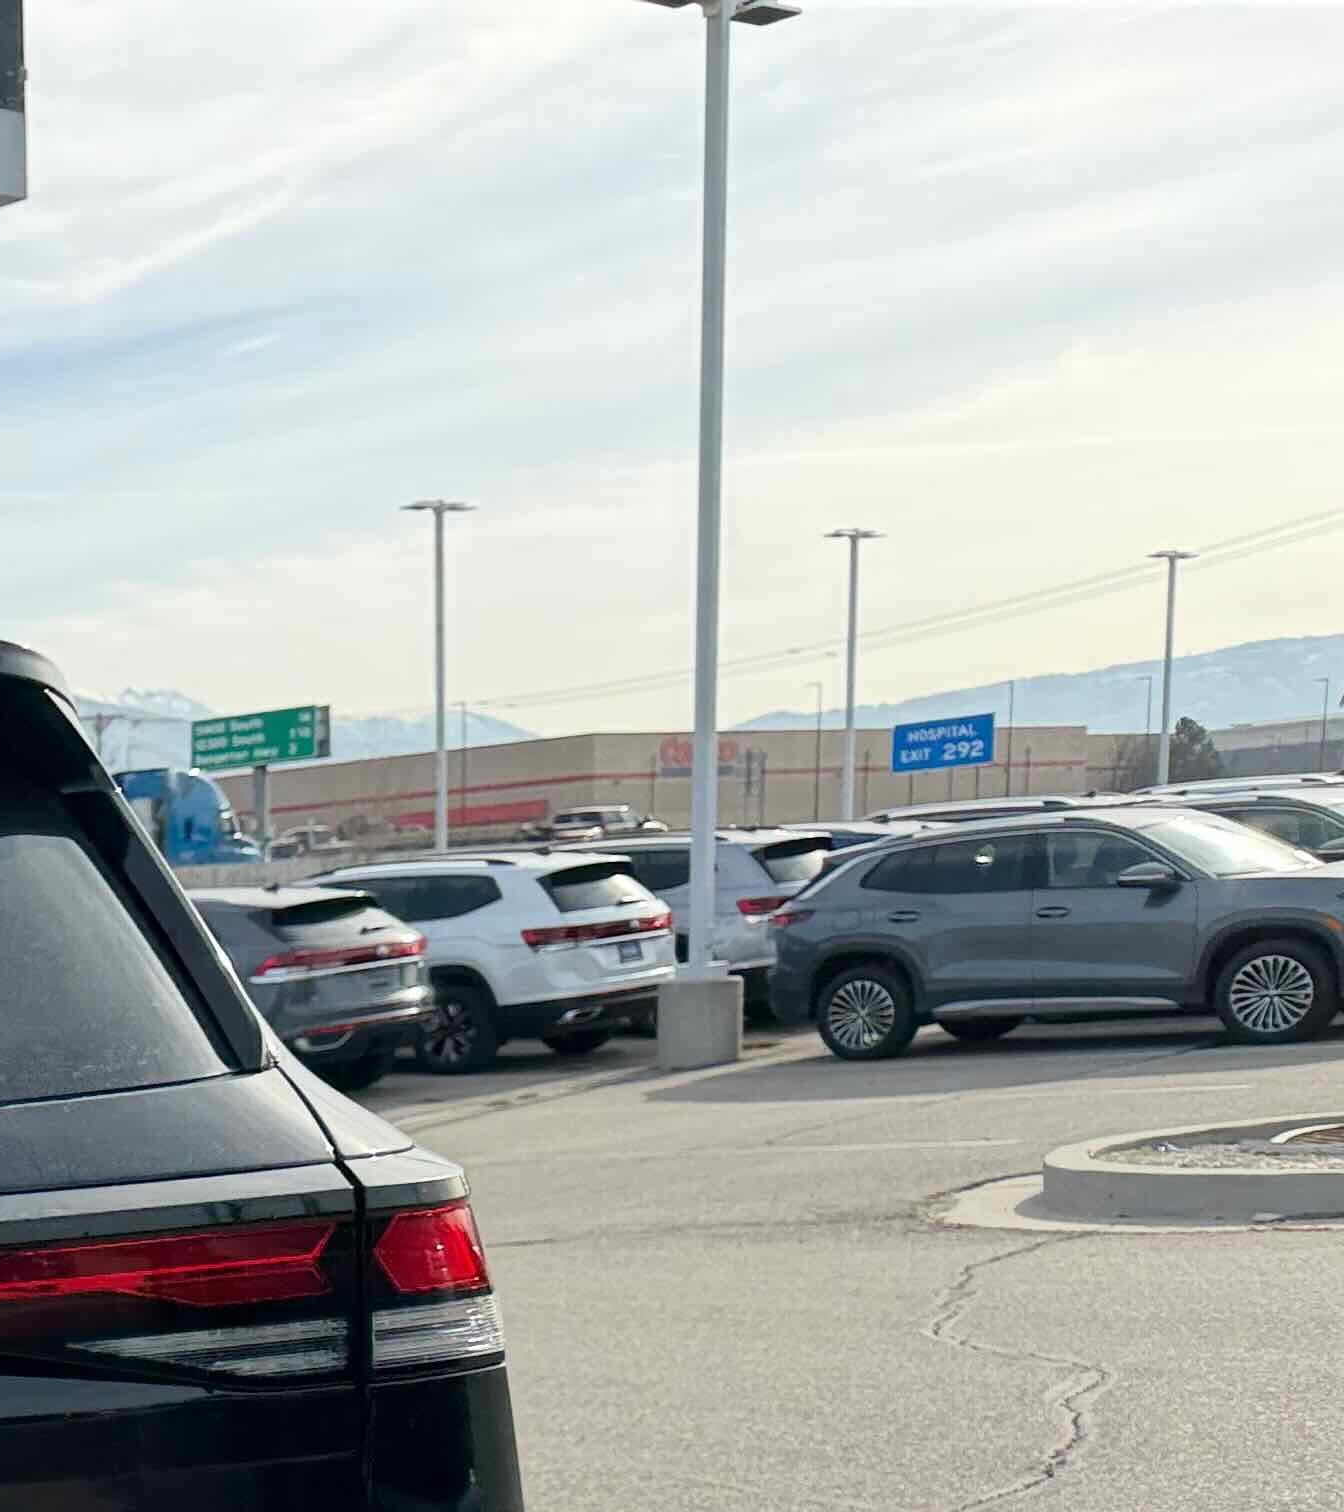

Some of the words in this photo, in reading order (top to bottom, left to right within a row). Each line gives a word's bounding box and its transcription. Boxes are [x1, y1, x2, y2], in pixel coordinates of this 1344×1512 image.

[907, 724, 976, 742] HOSPITAL
[900, 748, 931, 763] EXIT
[942, 740, 985, 760] 292
